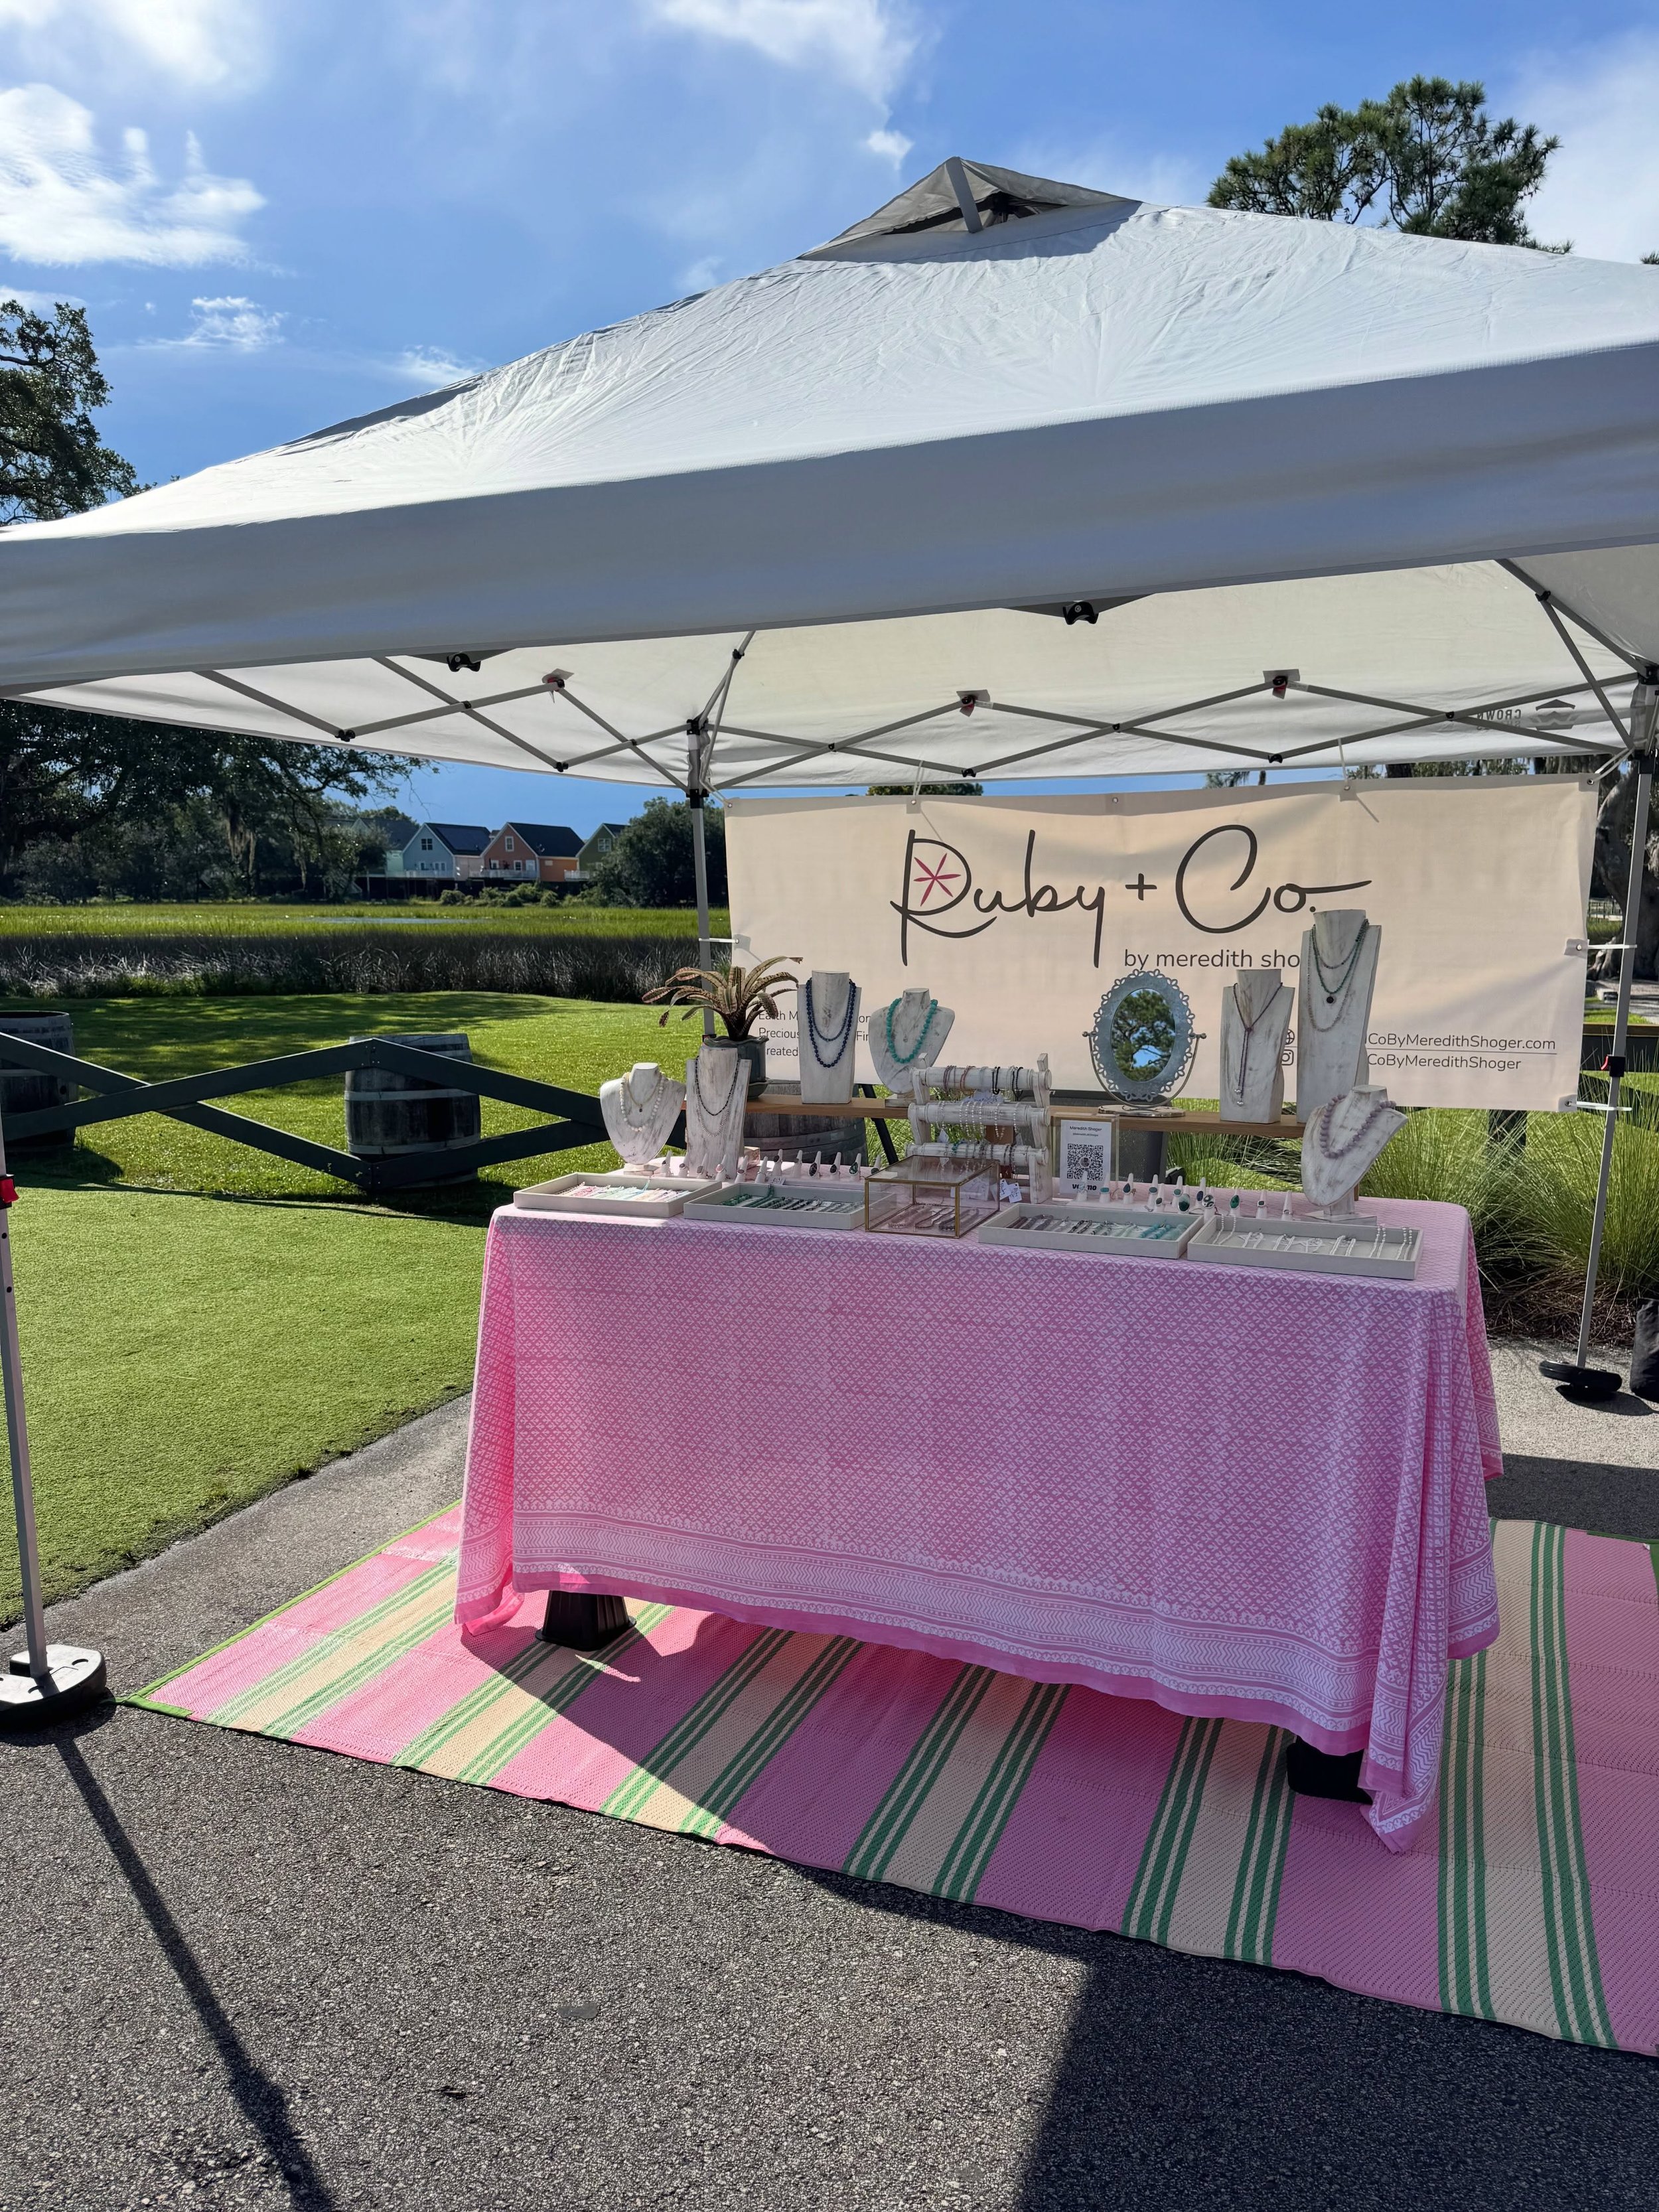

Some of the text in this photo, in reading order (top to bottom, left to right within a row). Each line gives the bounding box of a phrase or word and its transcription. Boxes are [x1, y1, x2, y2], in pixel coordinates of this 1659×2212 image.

[890, 829, 1106, 968] Ruby
[1124, 949, 1301, 970] by meredith sho
[758, 1010, 786, 1021] Eah
[1365, 1033, 1556, 1051] CoByMeredithShoger.com
[766, 1047, 798, 1057] reated
[1368, 1054, 1522, 1072] CoByMeredithShoger
